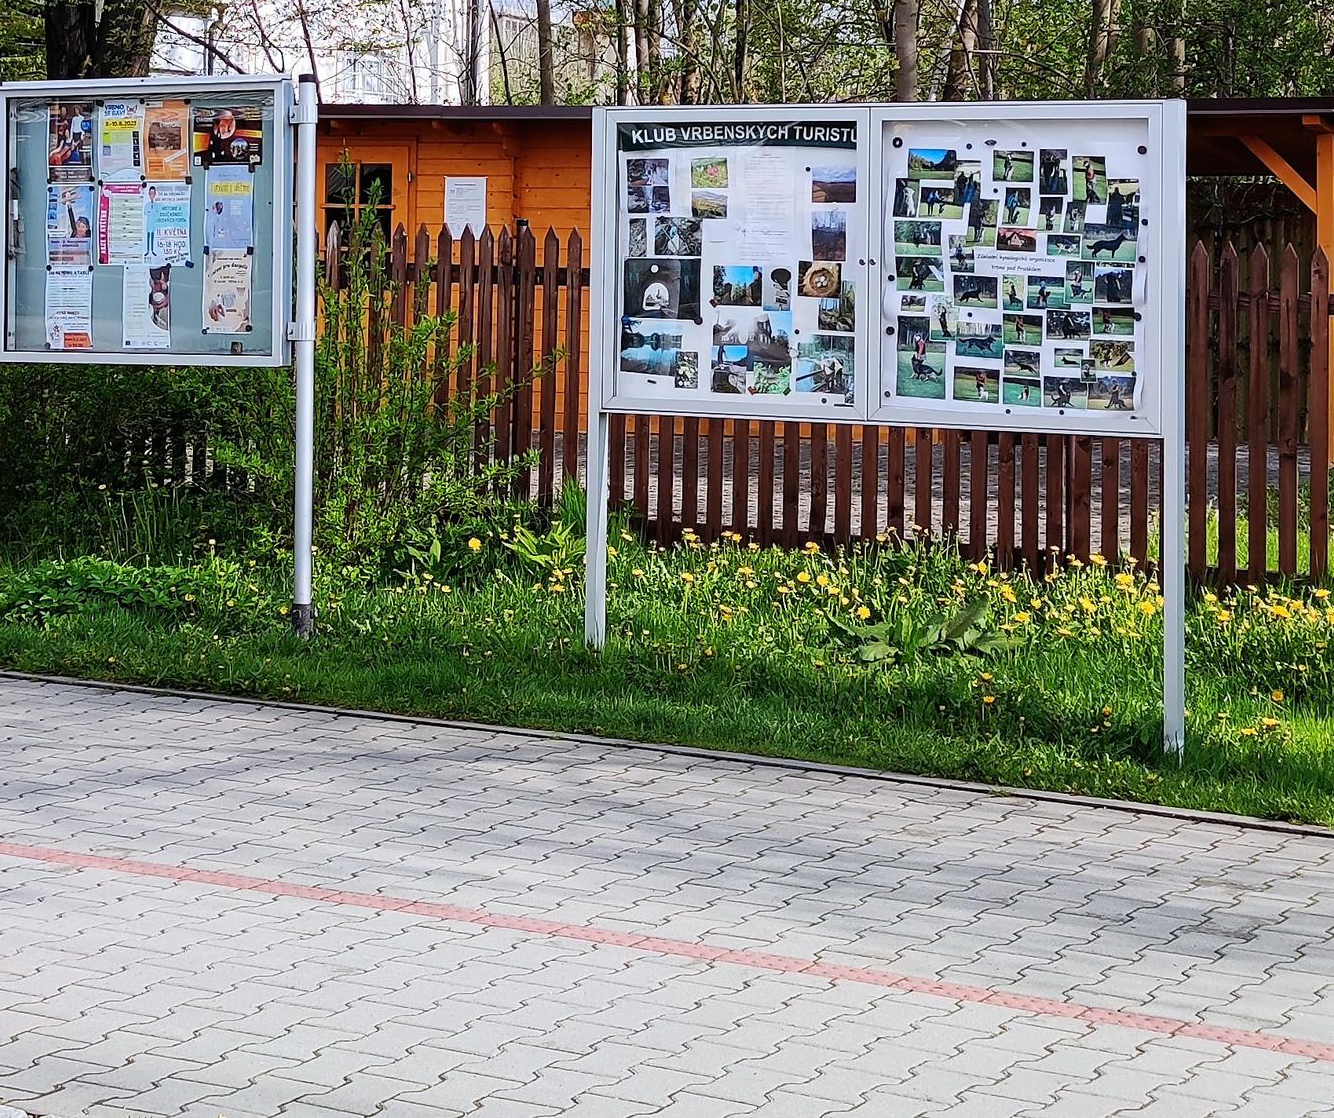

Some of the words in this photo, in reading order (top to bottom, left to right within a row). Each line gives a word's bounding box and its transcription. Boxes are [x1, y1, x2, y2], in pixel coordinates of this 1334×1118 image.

[631, 128, 677, 144] KLUB
[680, 123, 788, 141] VRBENSKÝCH
[163, 227, 187, 236] KVĚTNA
